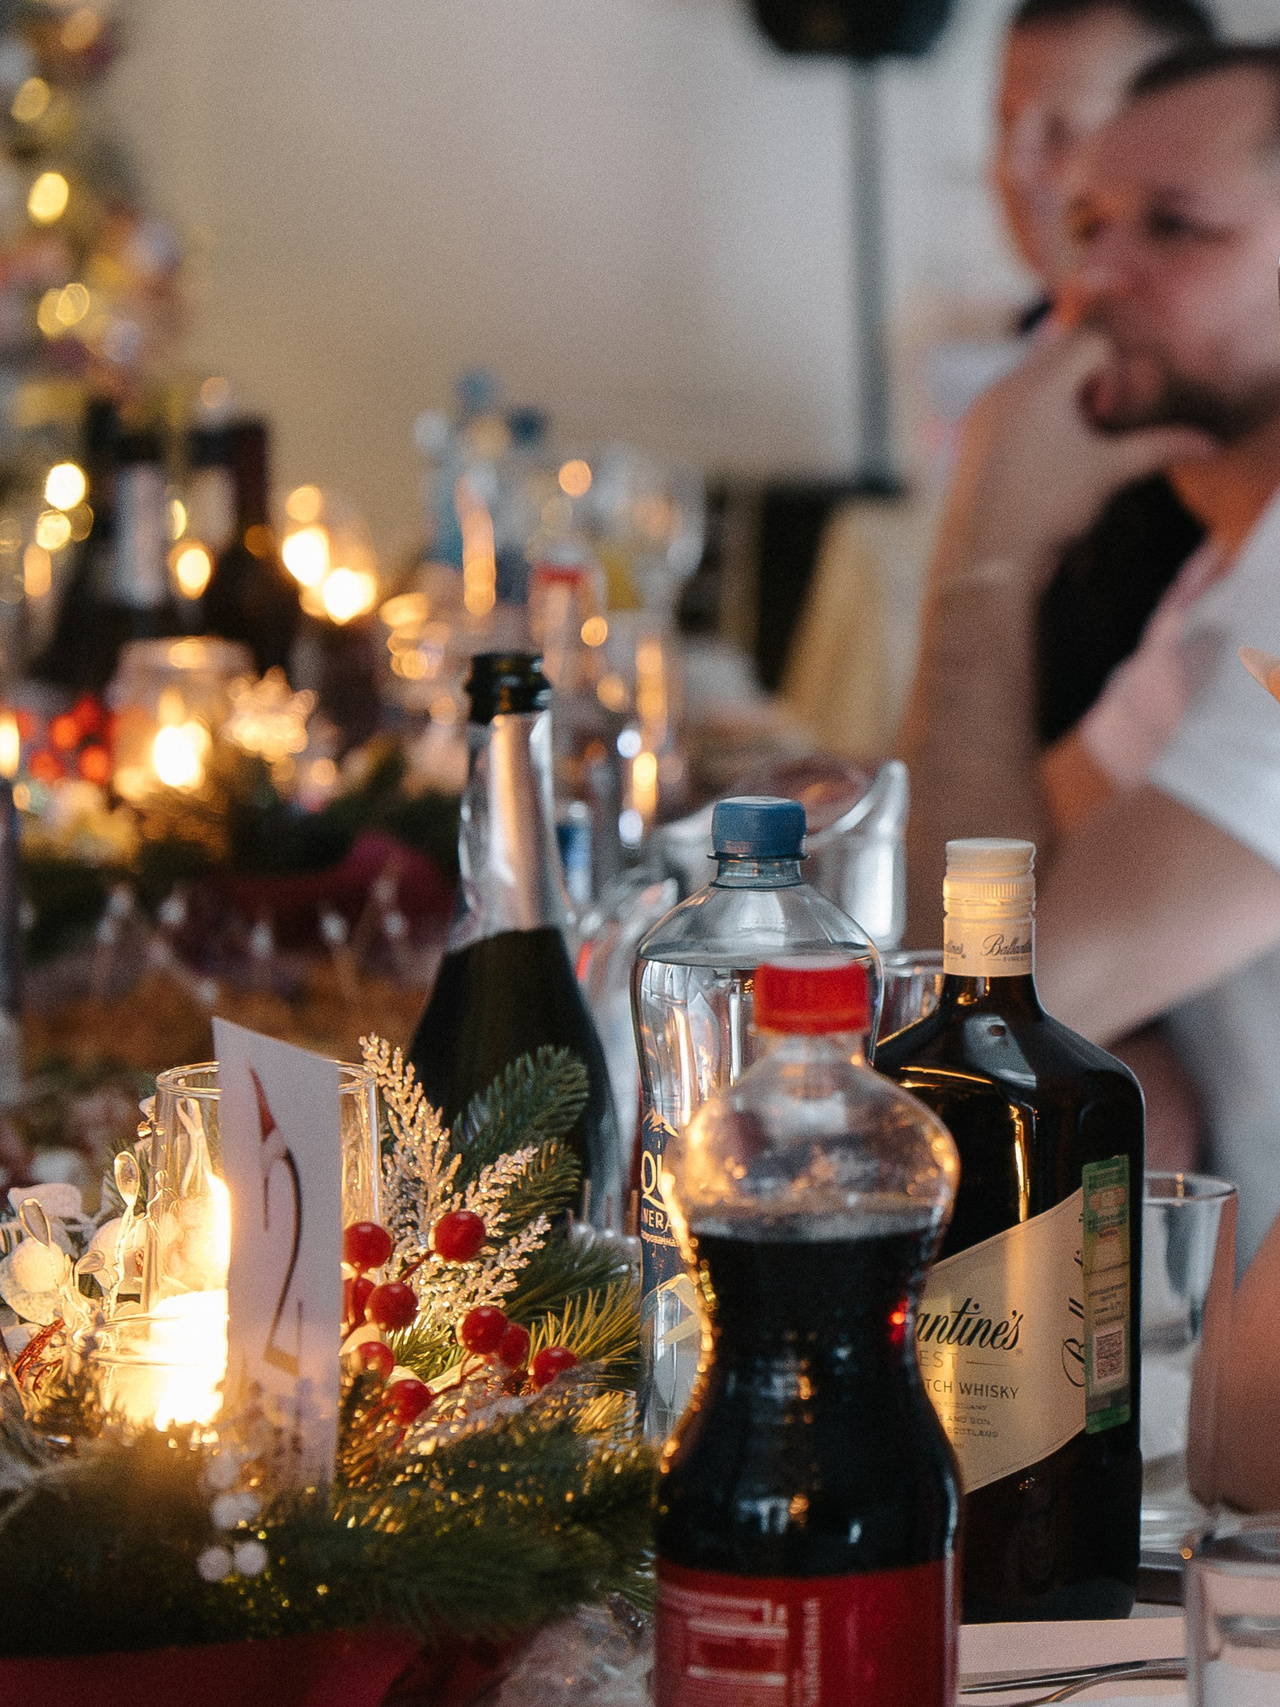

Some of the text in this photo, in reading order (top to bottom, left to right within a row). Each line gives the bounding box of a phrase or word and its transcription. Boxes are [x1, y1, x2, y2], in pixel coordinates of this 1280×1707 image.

[916, 1296, 1024, 1351] antine's
[919, 1350, 959, 1370] EST
[925, 1378, 1019, 1400] TCH WHISKY
